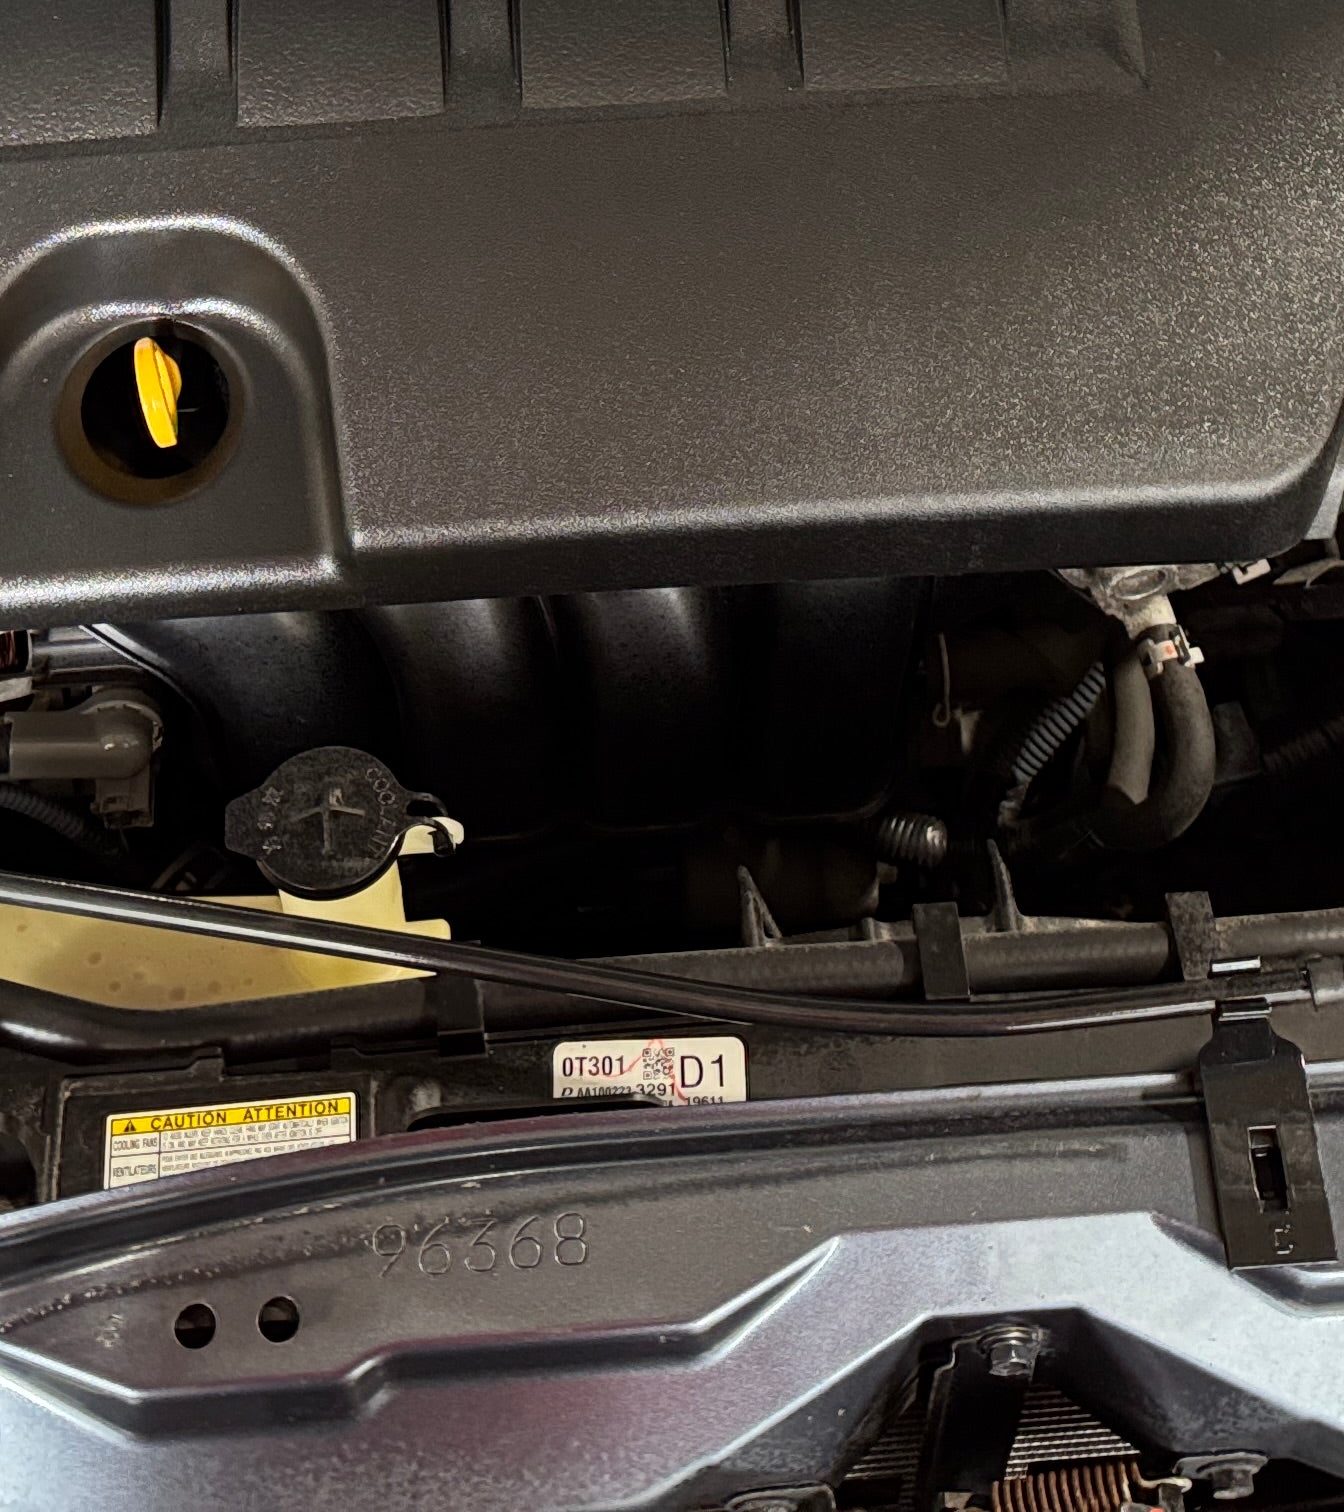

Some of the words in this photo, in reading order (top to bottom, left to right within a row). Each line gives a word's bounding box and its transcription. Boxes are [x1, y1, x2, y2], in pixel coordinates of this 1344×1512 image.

[680, 1054, 725, 1089] D1
[150, 1110, 227, 1131] CAUTION
[242, 1099, 340, 1122] ATTENTION
[370, 1210, 589, 1280] 96368
